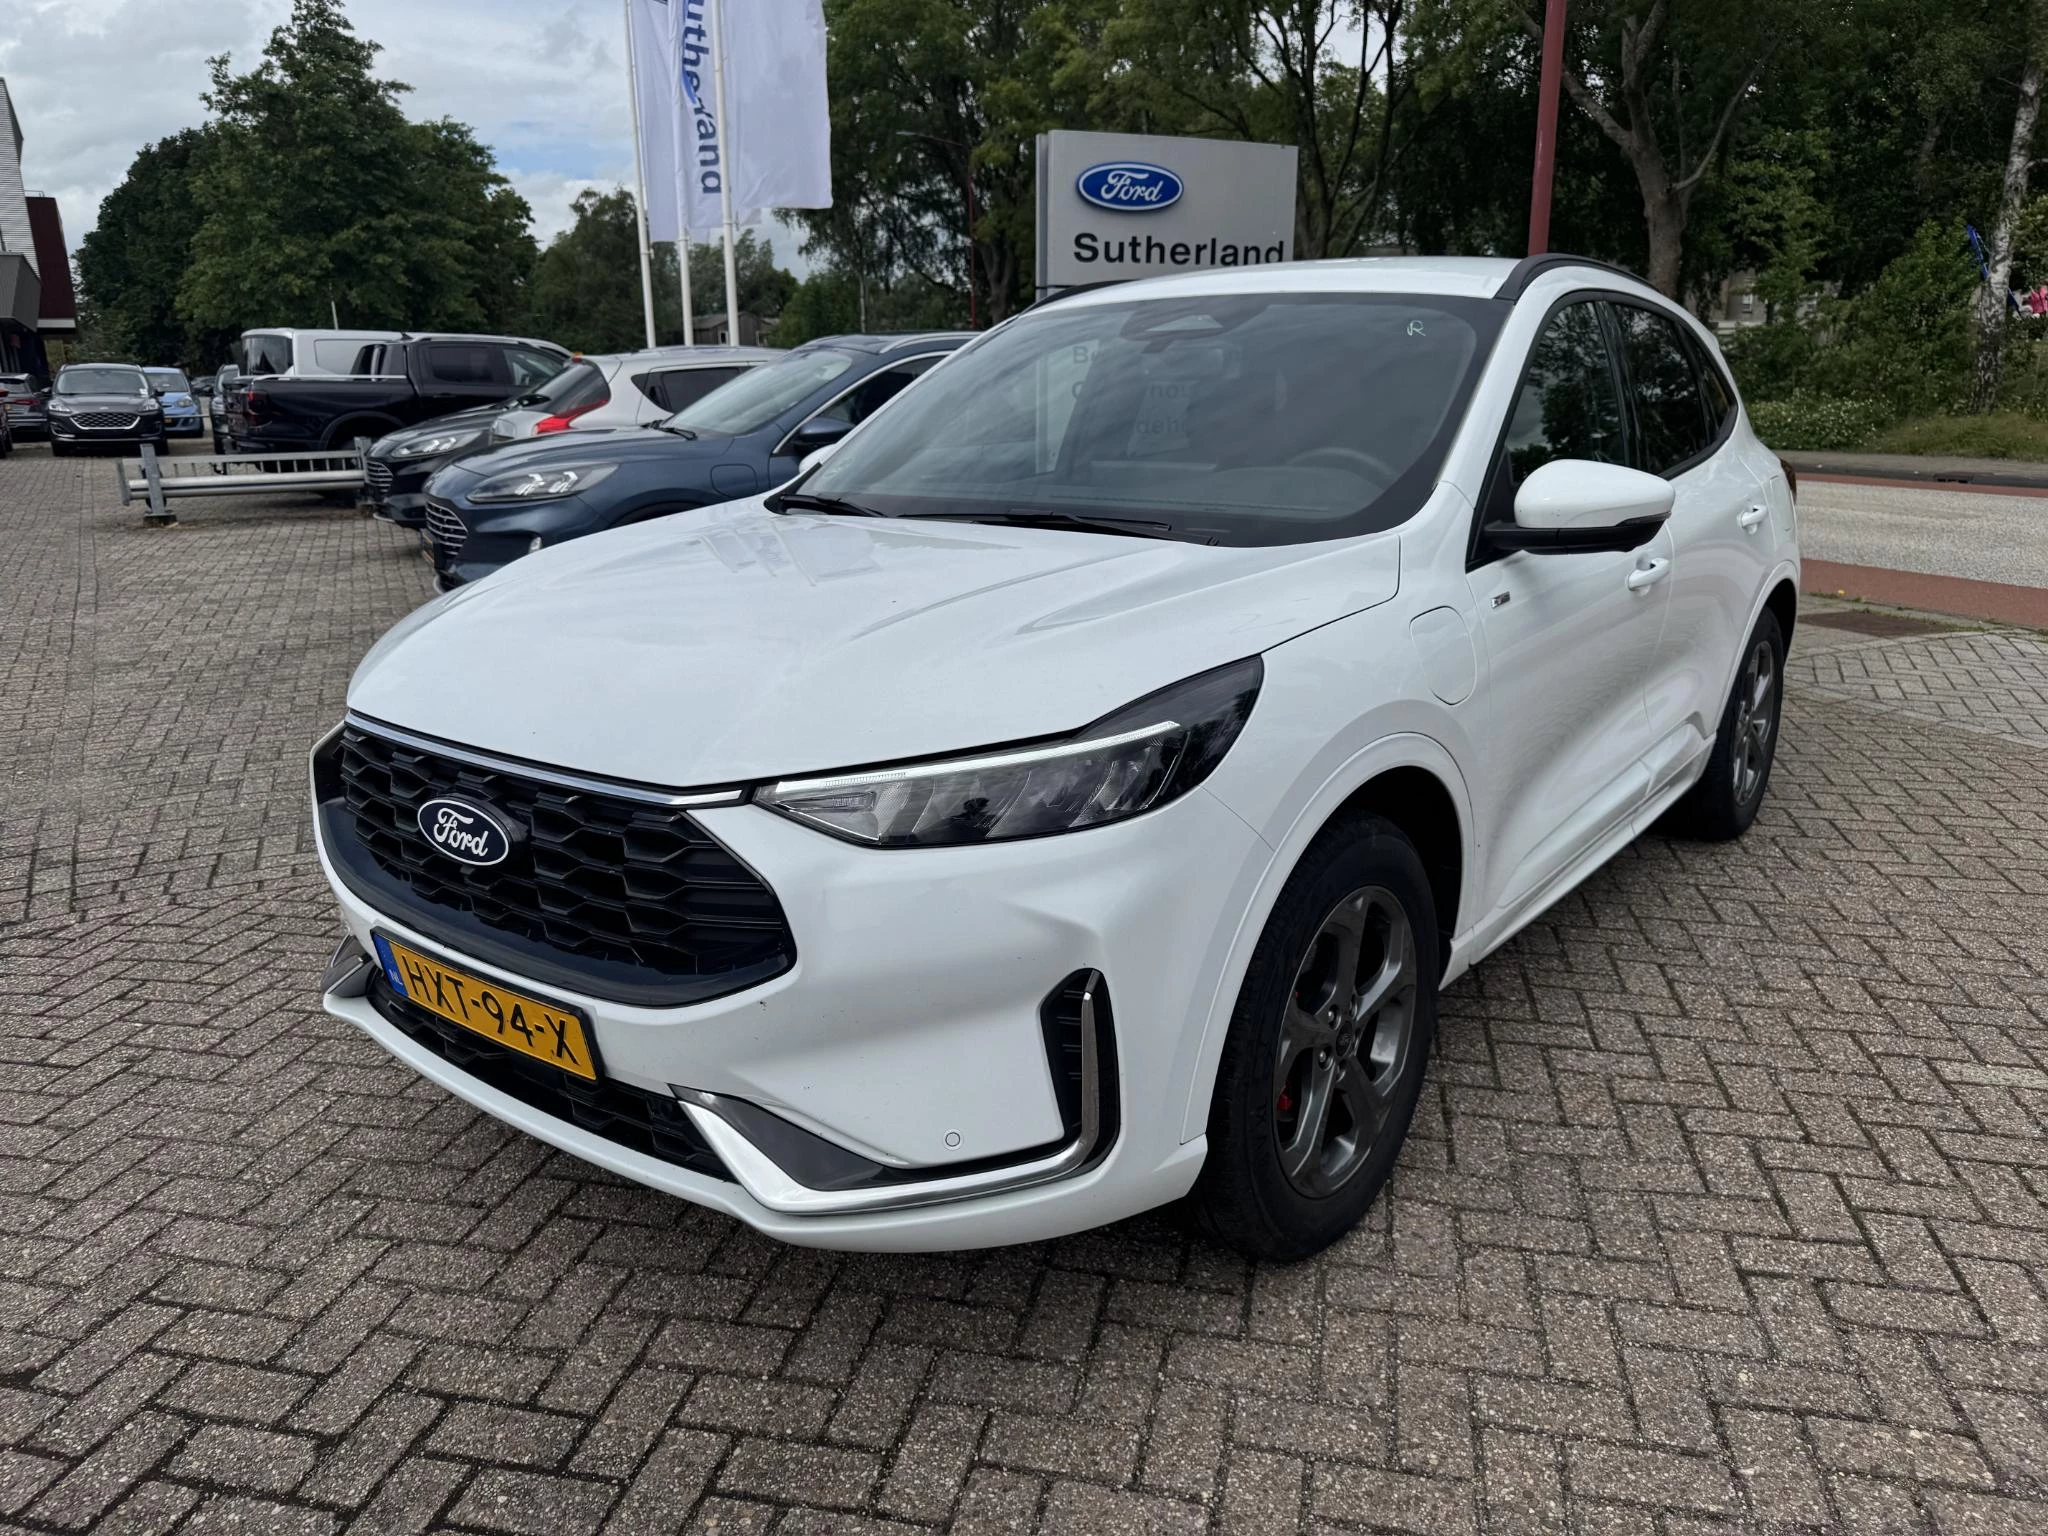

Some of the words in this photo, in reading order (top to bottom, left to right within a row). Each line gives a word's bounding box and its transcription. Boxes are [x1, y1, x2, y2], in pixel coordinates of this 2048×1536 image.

[1101, 170, 1163, 201] Ford
[1074, 232, 1284, 266] Sutherland
[433, 807, 489, 857] Ford
[389, 968, 403, 986] NL
[402, 954, 580, 1065] HXT-94-X
